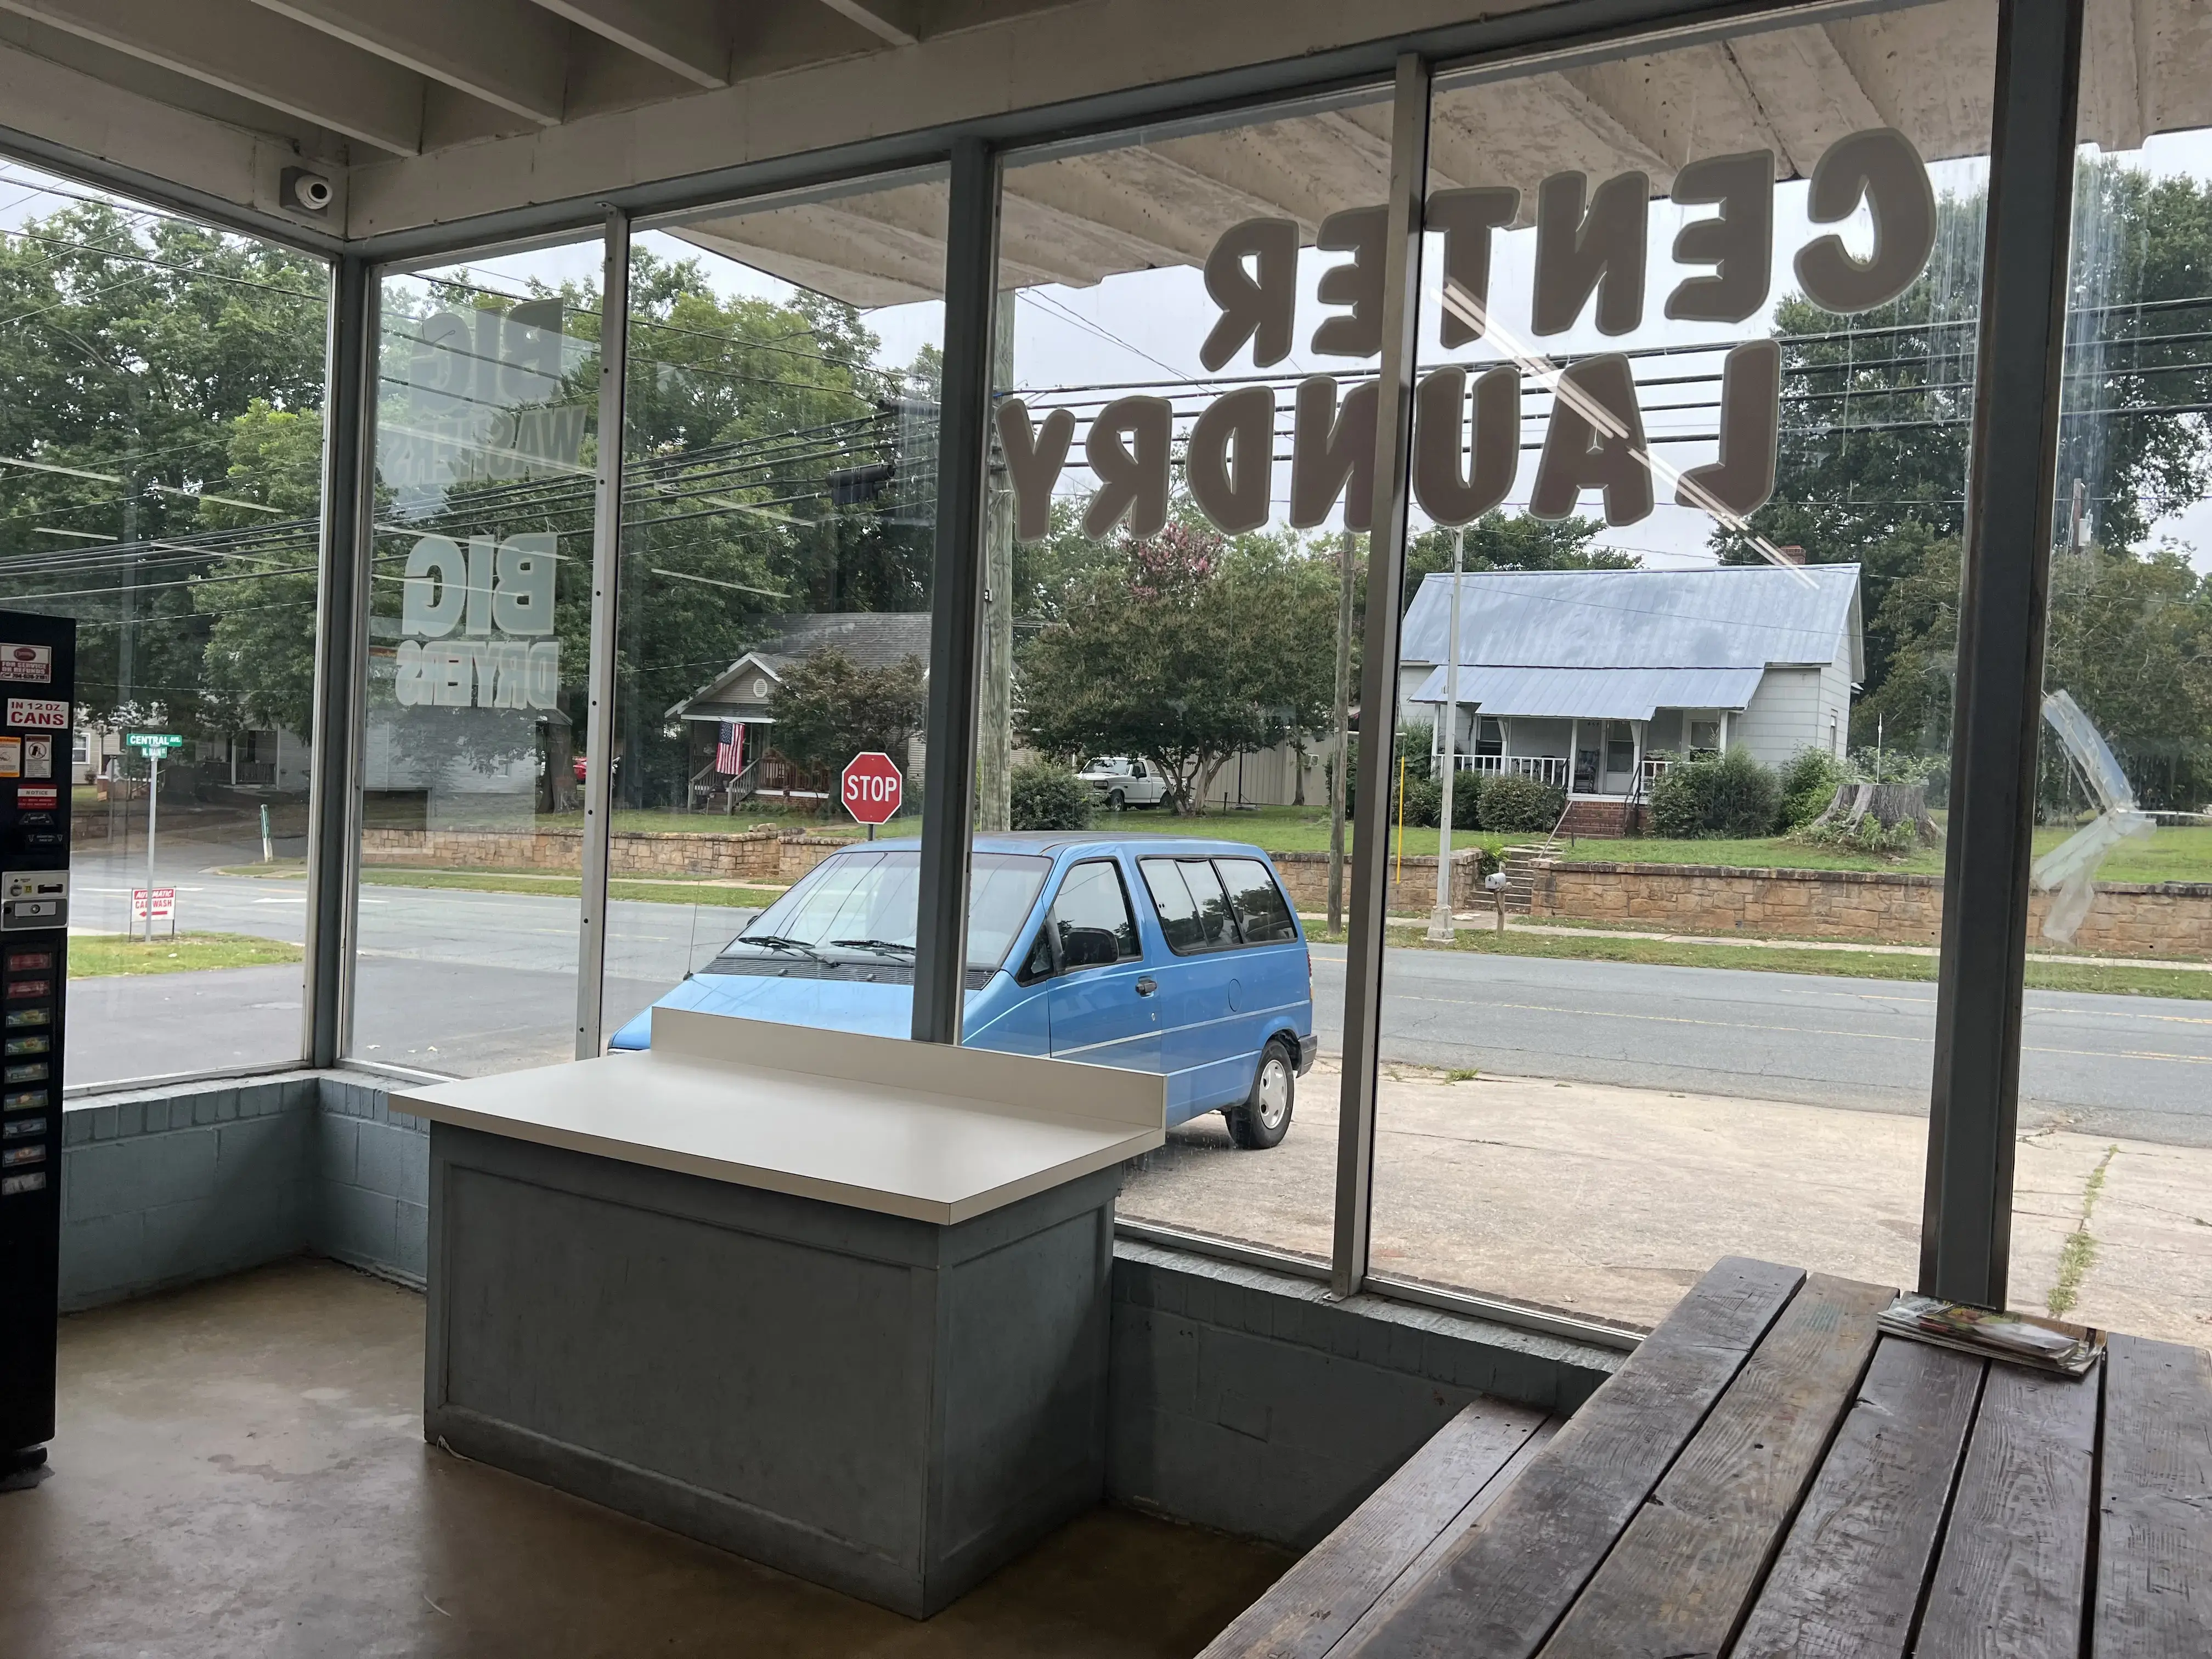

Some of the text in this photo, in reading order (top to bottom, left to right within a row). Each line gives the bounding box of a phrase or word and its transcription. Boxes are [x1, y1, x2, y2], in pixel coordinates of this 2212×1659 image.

[12, 712, 64, 725] CANS
[130, 735, 169, 745] CENTRAL
[847, 775, 897, 802] STOP
[136, 890, 172, 899] AUTMATIC
[153, 900, 172, 908] WASH
